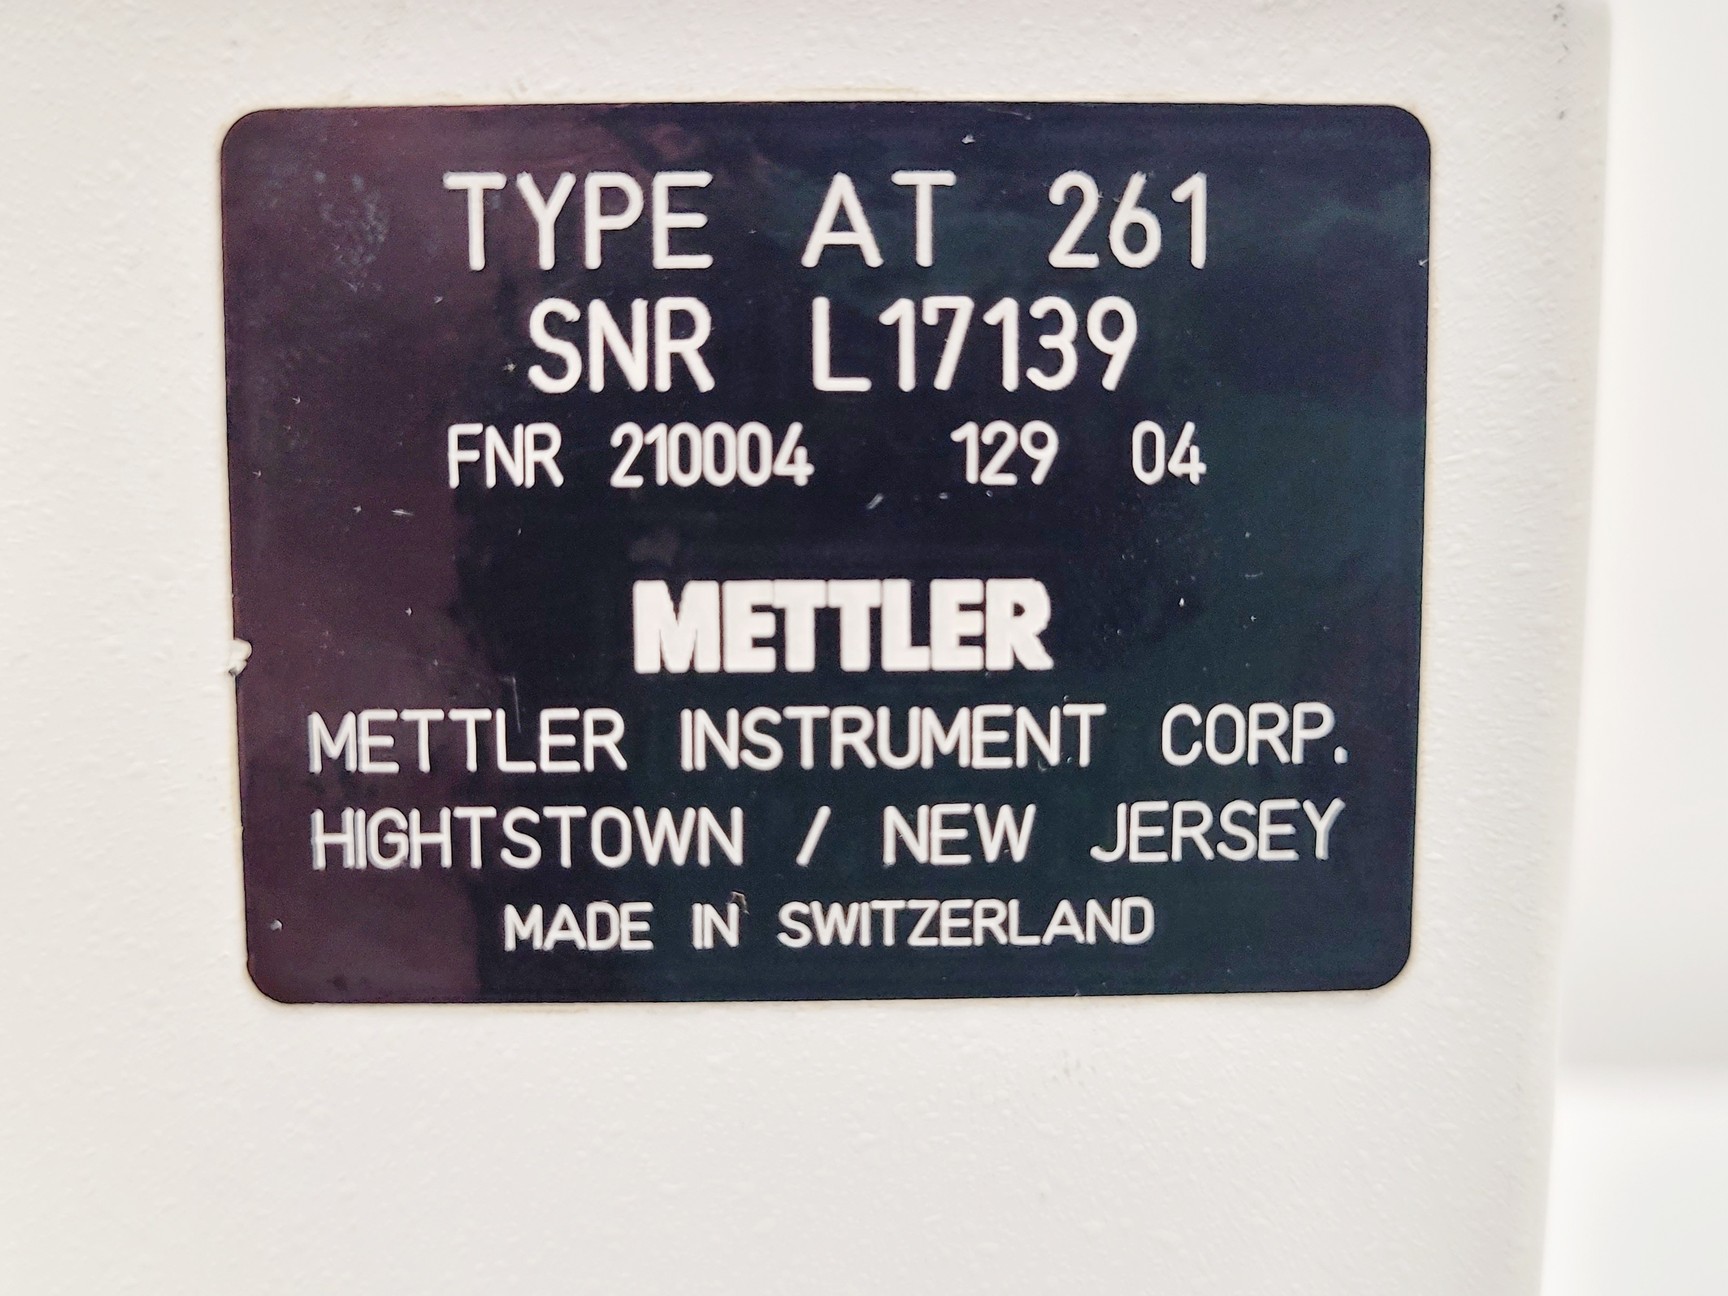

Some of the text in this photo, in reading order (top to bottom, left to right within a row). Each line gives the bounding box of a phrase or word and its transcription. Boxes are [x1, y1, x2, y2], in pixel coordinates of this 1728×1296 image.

[443, 170, 1207, 270] TYPE AT 261
[528, 296, 1137, 393] SNR L17139
[448, 420, 1206, 488] FNR 210004 129 04
[633, 579, 1054, 674] METTLER
[308, 702, 1347, 773] METTLER INSTRUMENT CORP.
[311, 798, 1345, 870] HIGHTSTOWN / NEW JERSEY
[504, 897, 1154, 951] MADE IN SWITZERLAND
